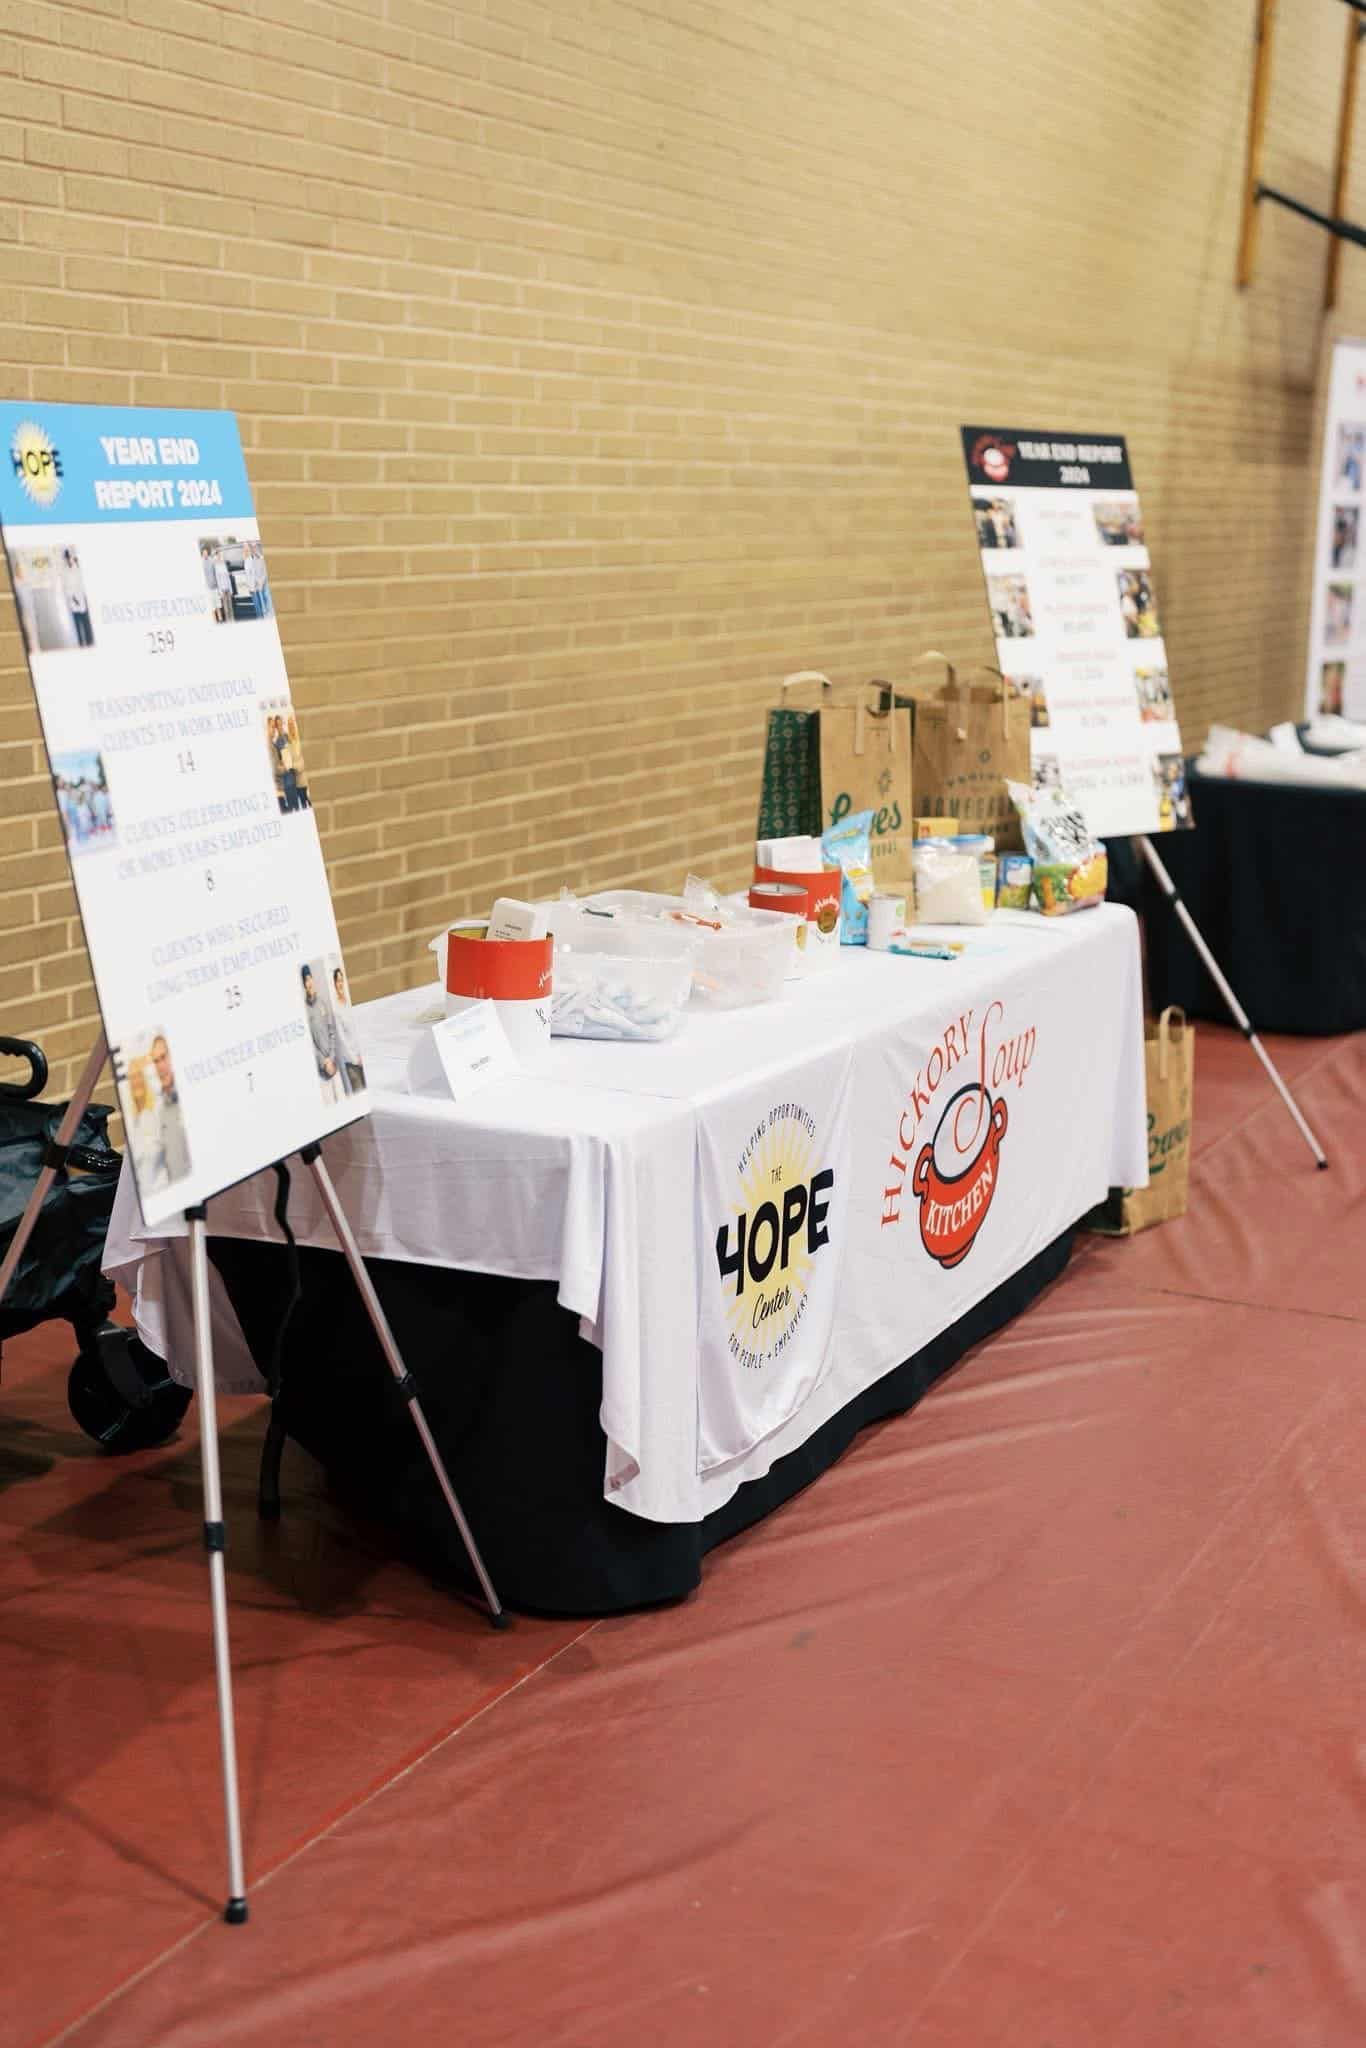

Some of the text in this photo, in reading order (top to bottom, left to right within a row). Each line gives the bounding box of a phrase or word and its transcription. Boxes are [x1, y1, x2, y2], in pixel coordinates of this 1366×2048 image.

[10, 449, 64, 478] HOPE
[100, 436, 200, 465] YEAR END
[94, 479, 223, 510] REPORT 2024
[136, 596, 209, 621] OPERATING
[147, 630, 175, 654] 259
[88, 687, 184, 720] TRANSPORTING
[103, 725, 156, 752] CLIENTS
[216, 708, 250, 731] DAILY
[177, 751, 196, 773] 14
[219, 820, 282, 852] EMPLOYED
[238, 904, 290, 937] SECURED
[222, 932, 301, 977] EMPLOYMENT
[184, 1038, 254, 1084] VOLUNTEER
[880, 1000, 1037, 1228] HICKORY Soup
[737, 1103, 817, 1174] HELPING OPPORTUNITIES
[771, 1165, 783, 1185] THE
[925, 1159, 995, 1236] KITCHEN
[715, 1168, 835, 1297] HOPE
[751, 1284, 793, 1329] Center
[727, 1332, 740, 1356] FOR
[738, 1348, 766, 1369] PEOPLE
